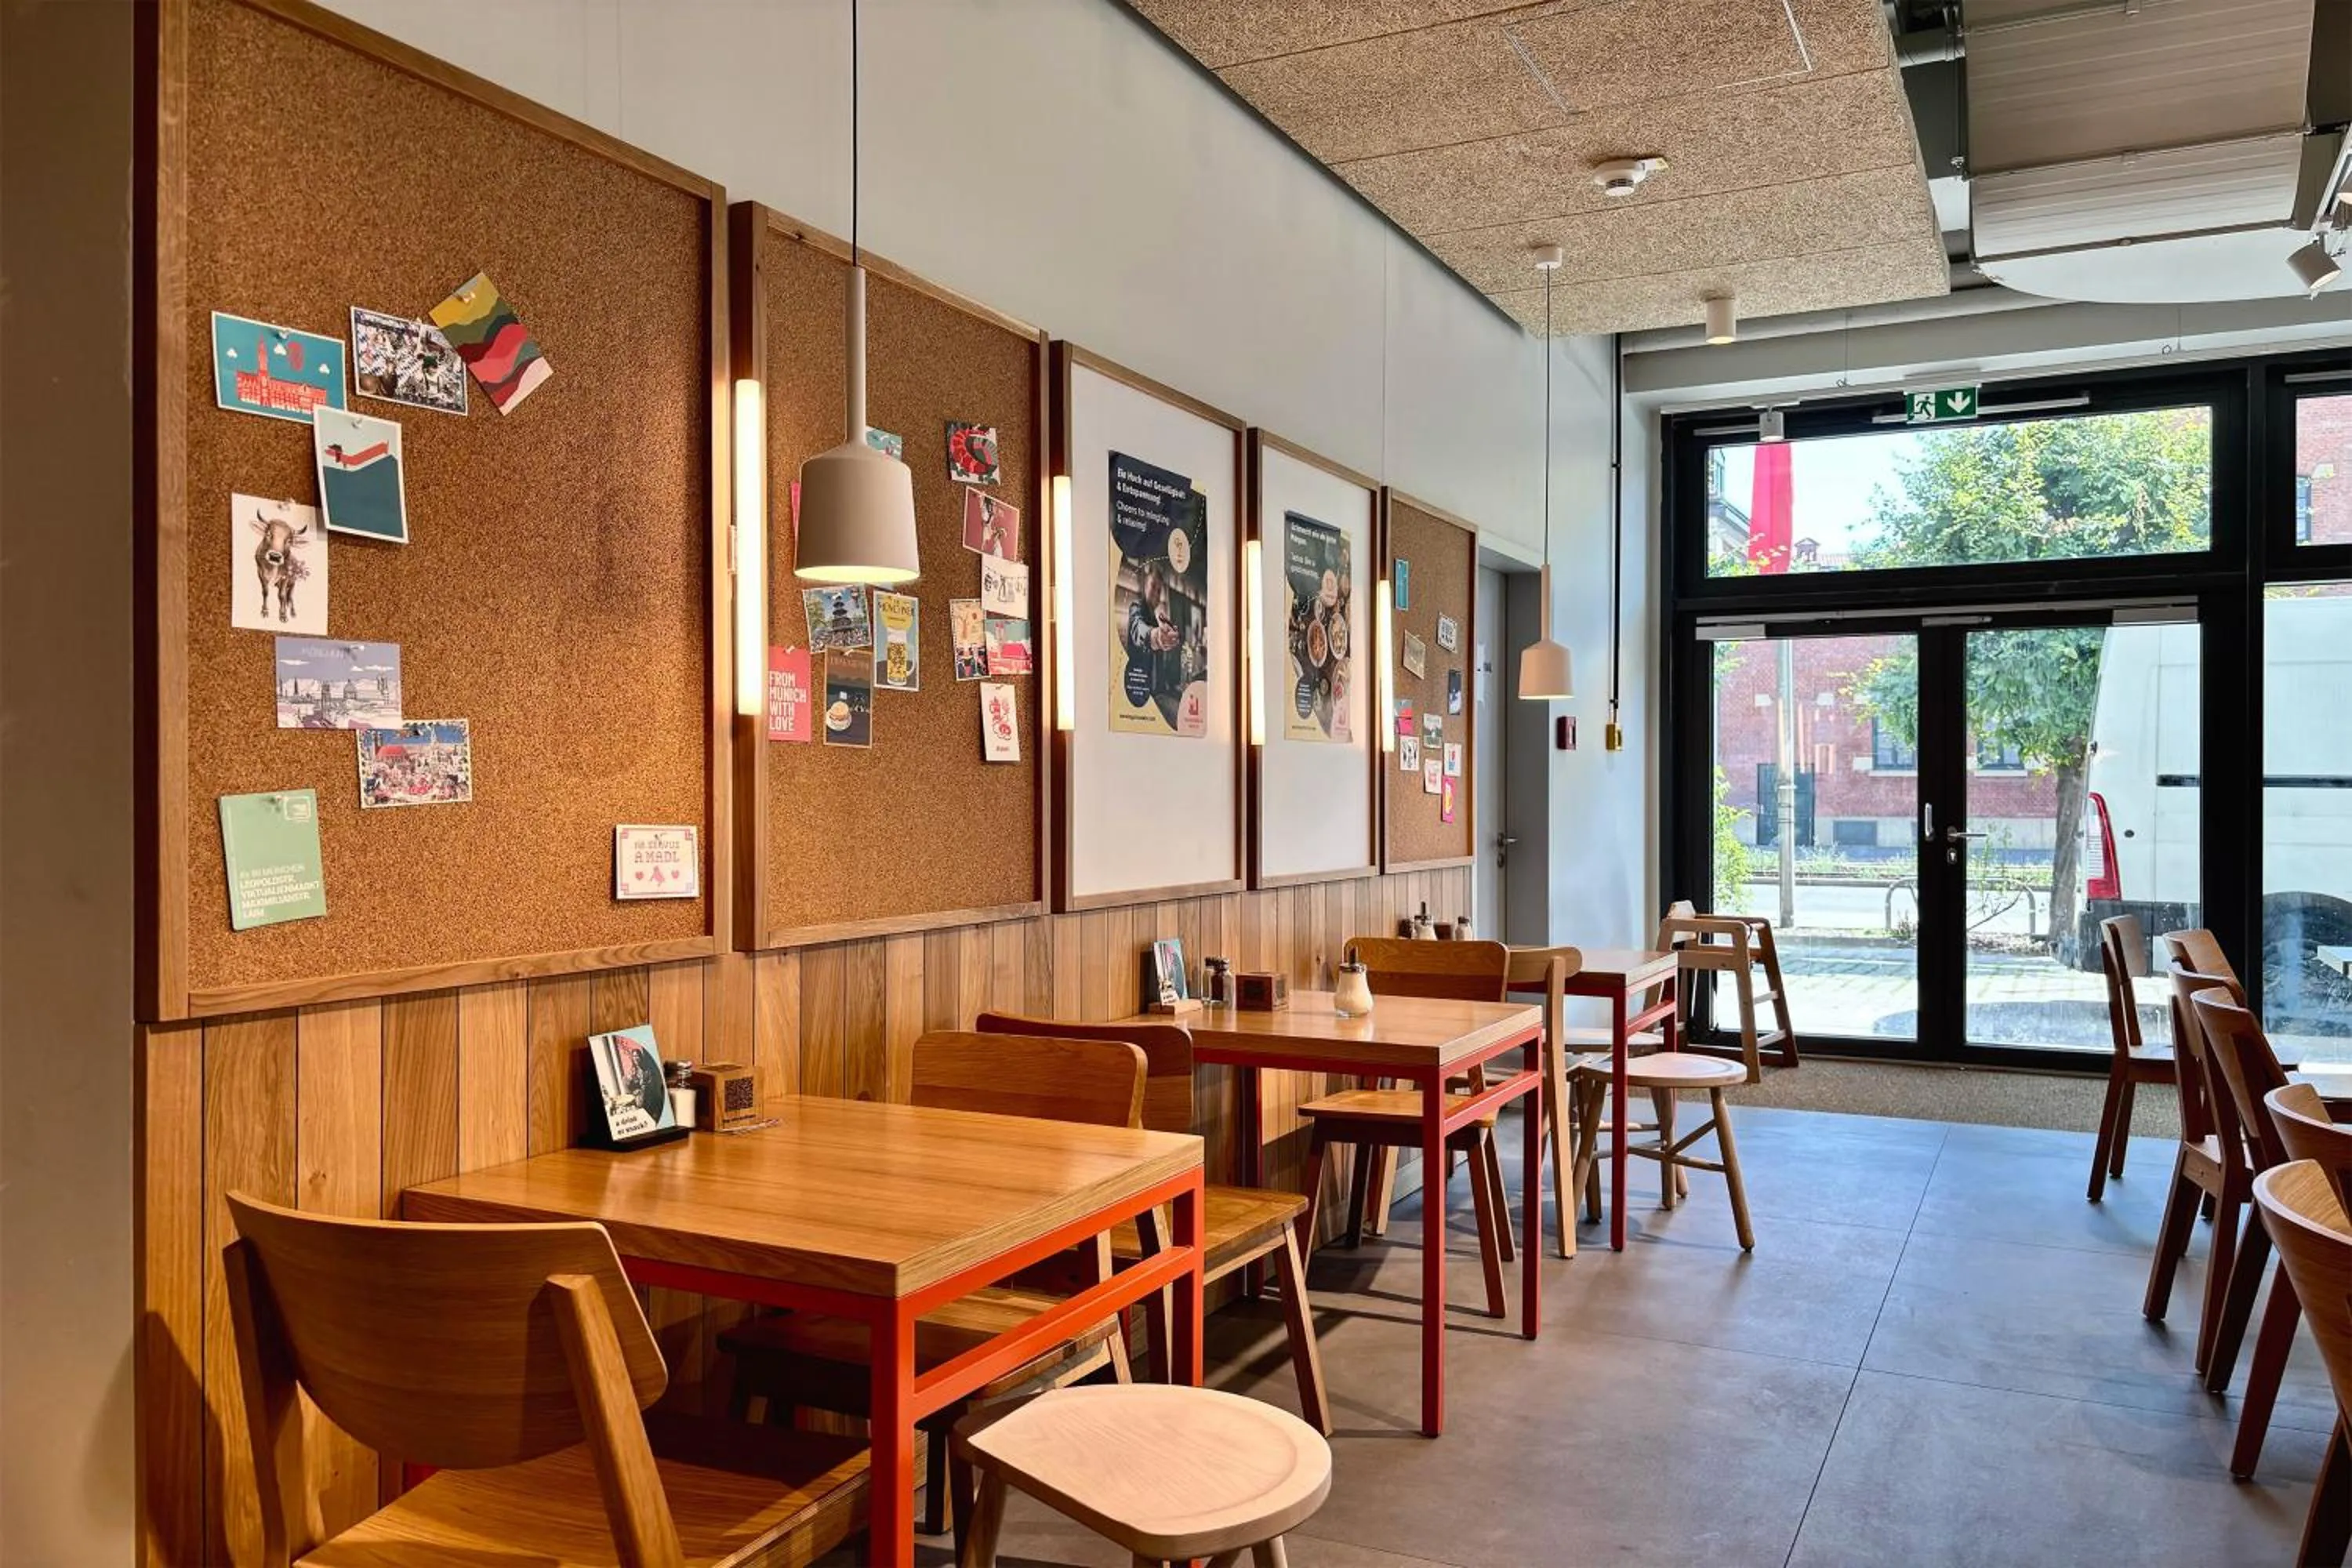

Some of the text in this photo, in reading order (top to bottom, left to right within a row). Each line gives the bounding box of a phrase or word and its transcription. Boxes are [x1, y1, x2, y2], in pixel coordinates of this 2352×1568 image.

[769, 670, 796, 688] FROM
[769, 687, 807, 702] MUNICH
[769, 701, 795, 717] WITH
[769, 716, 795, 731] LOVE
[634, 851, 681, 863] A MADL
